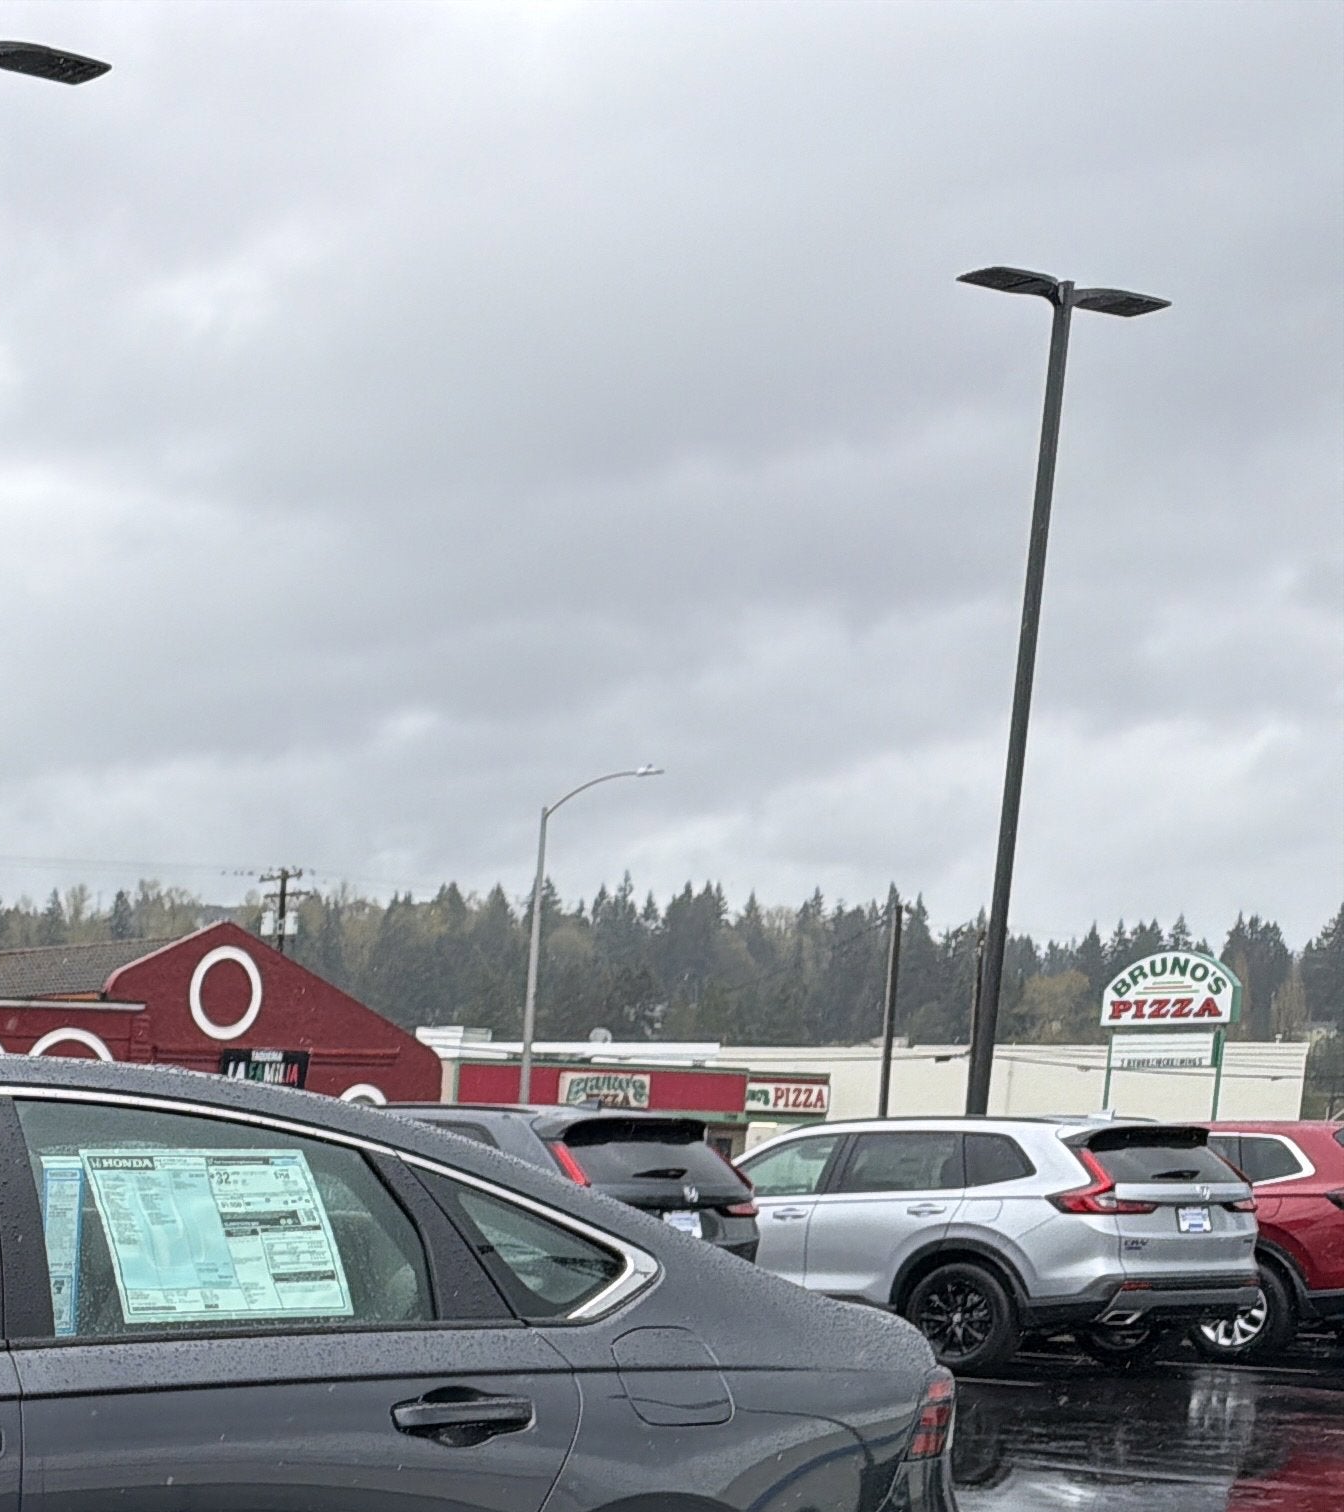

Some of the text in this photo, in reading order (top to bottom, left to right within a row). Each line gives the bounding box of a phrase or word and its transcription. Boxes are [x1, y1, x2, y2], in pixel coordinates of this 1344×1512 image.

[1112, 956, 1227, 998] BRUNO'S
[1108, 997, 1223, 1020] PIZZA
[227, 1061, 246, 1081] LA
[772, 1087, 826, 1109] PIZZA
[102, 1159, 153, 1168] HONDA
